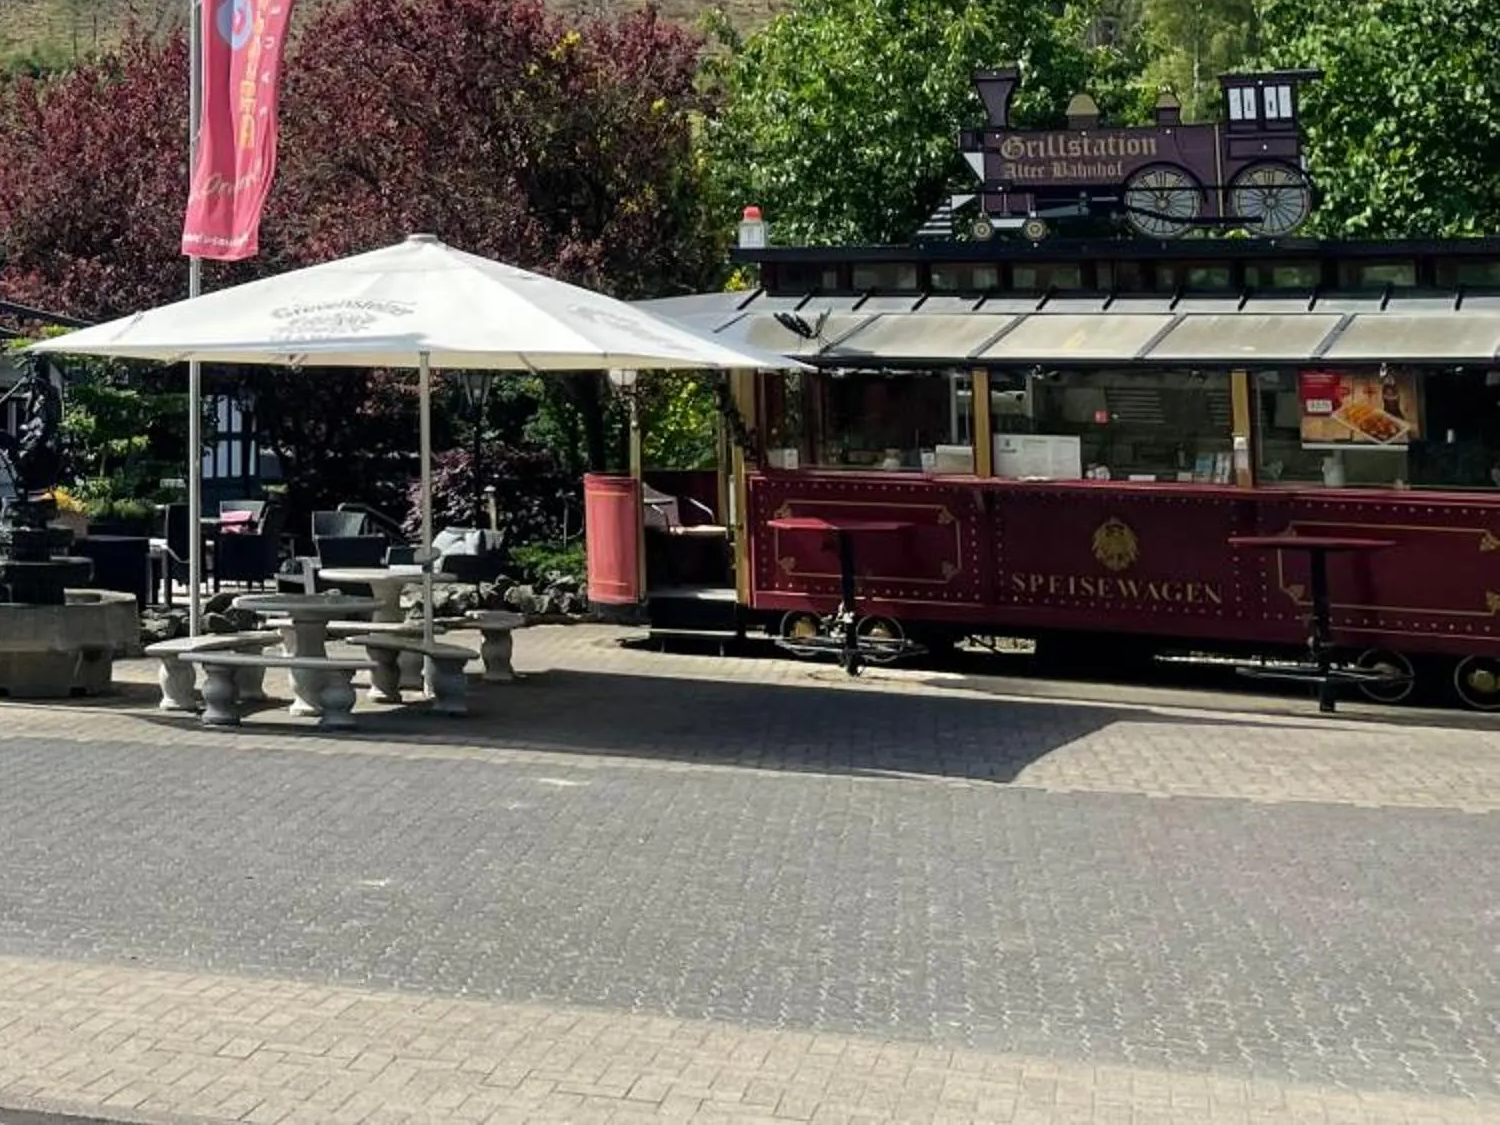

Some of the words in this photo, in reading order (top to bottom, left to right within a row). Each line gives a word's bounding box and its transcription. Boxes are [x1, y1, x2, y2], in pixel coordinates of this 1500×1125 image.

[1001, 133, 1158, 160] Grillstation
[1003, 163, 1046, 180] Alter
[1053, 161, 1122, 179] Bahnhof
[1012, 573, 1223, 605] SPEISEWAGEN
